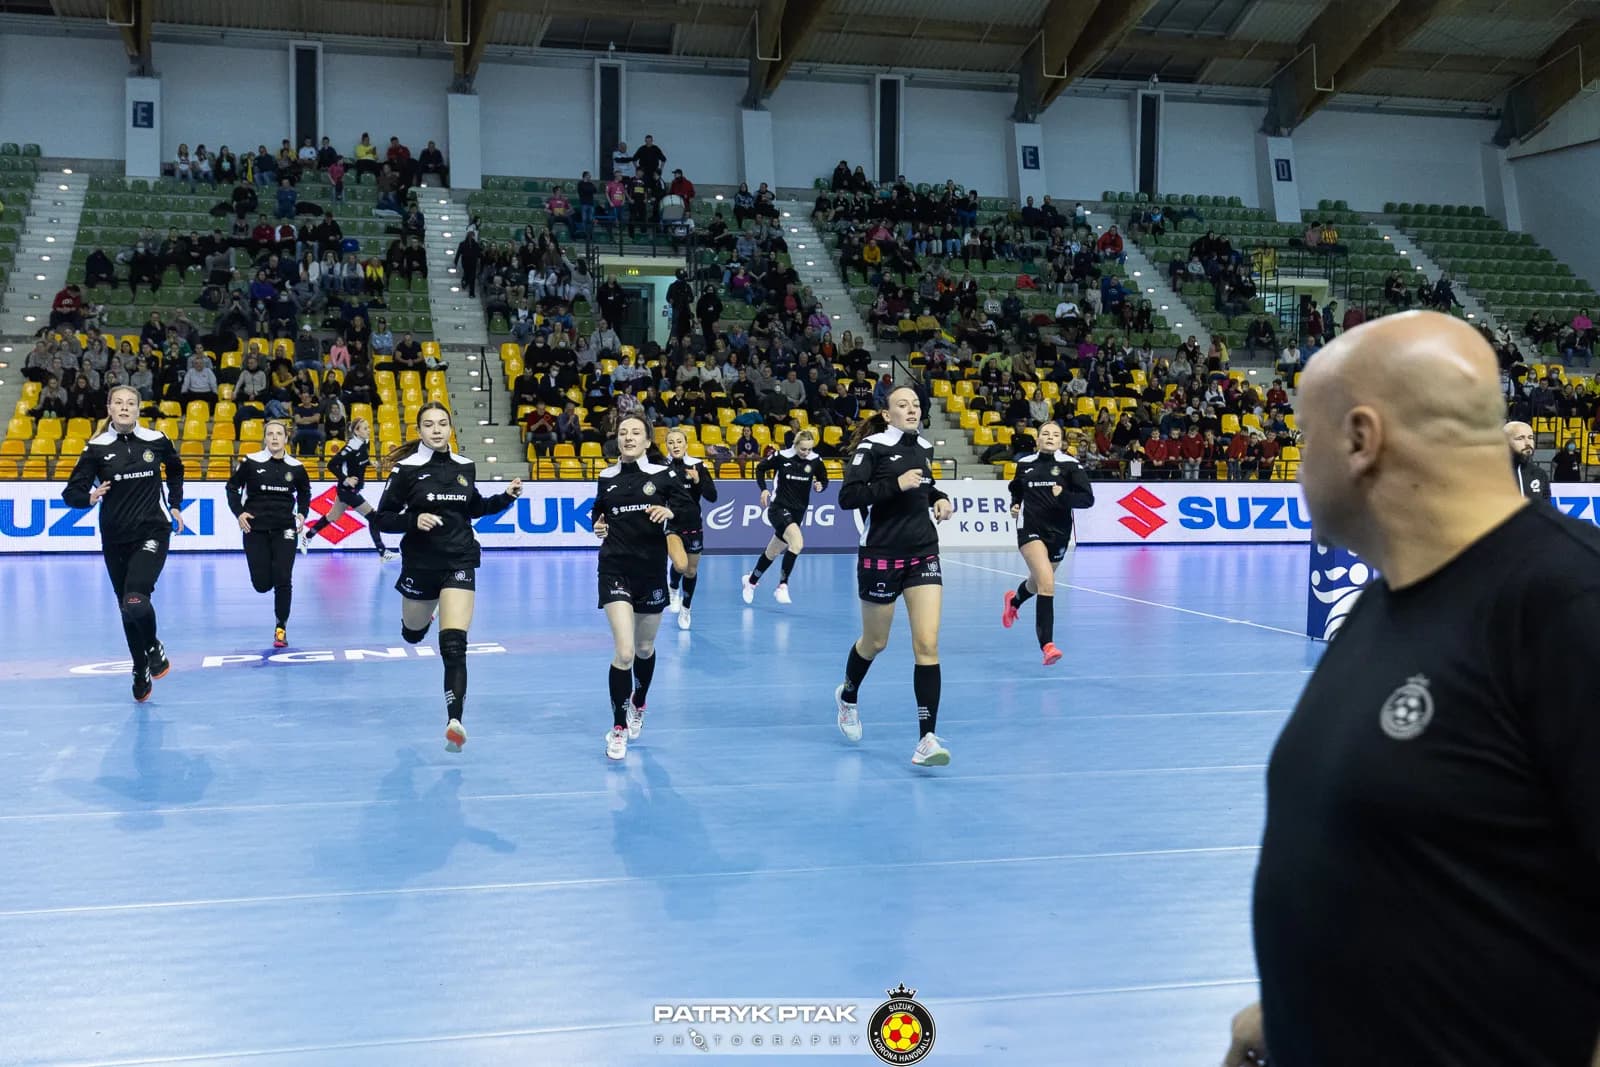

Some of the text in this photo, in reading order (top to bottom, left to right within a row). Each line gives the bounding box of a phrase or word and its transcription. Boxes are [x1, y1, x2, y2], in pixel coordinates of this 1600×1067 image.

[136, 103, 149, 126] E
[1025, 147, 1036, 167] E
[1277, 160, 1289, 180] D
[123, 470, 154, 480] SUZUKI
[436, 493, 467, 502] SUZUKI
